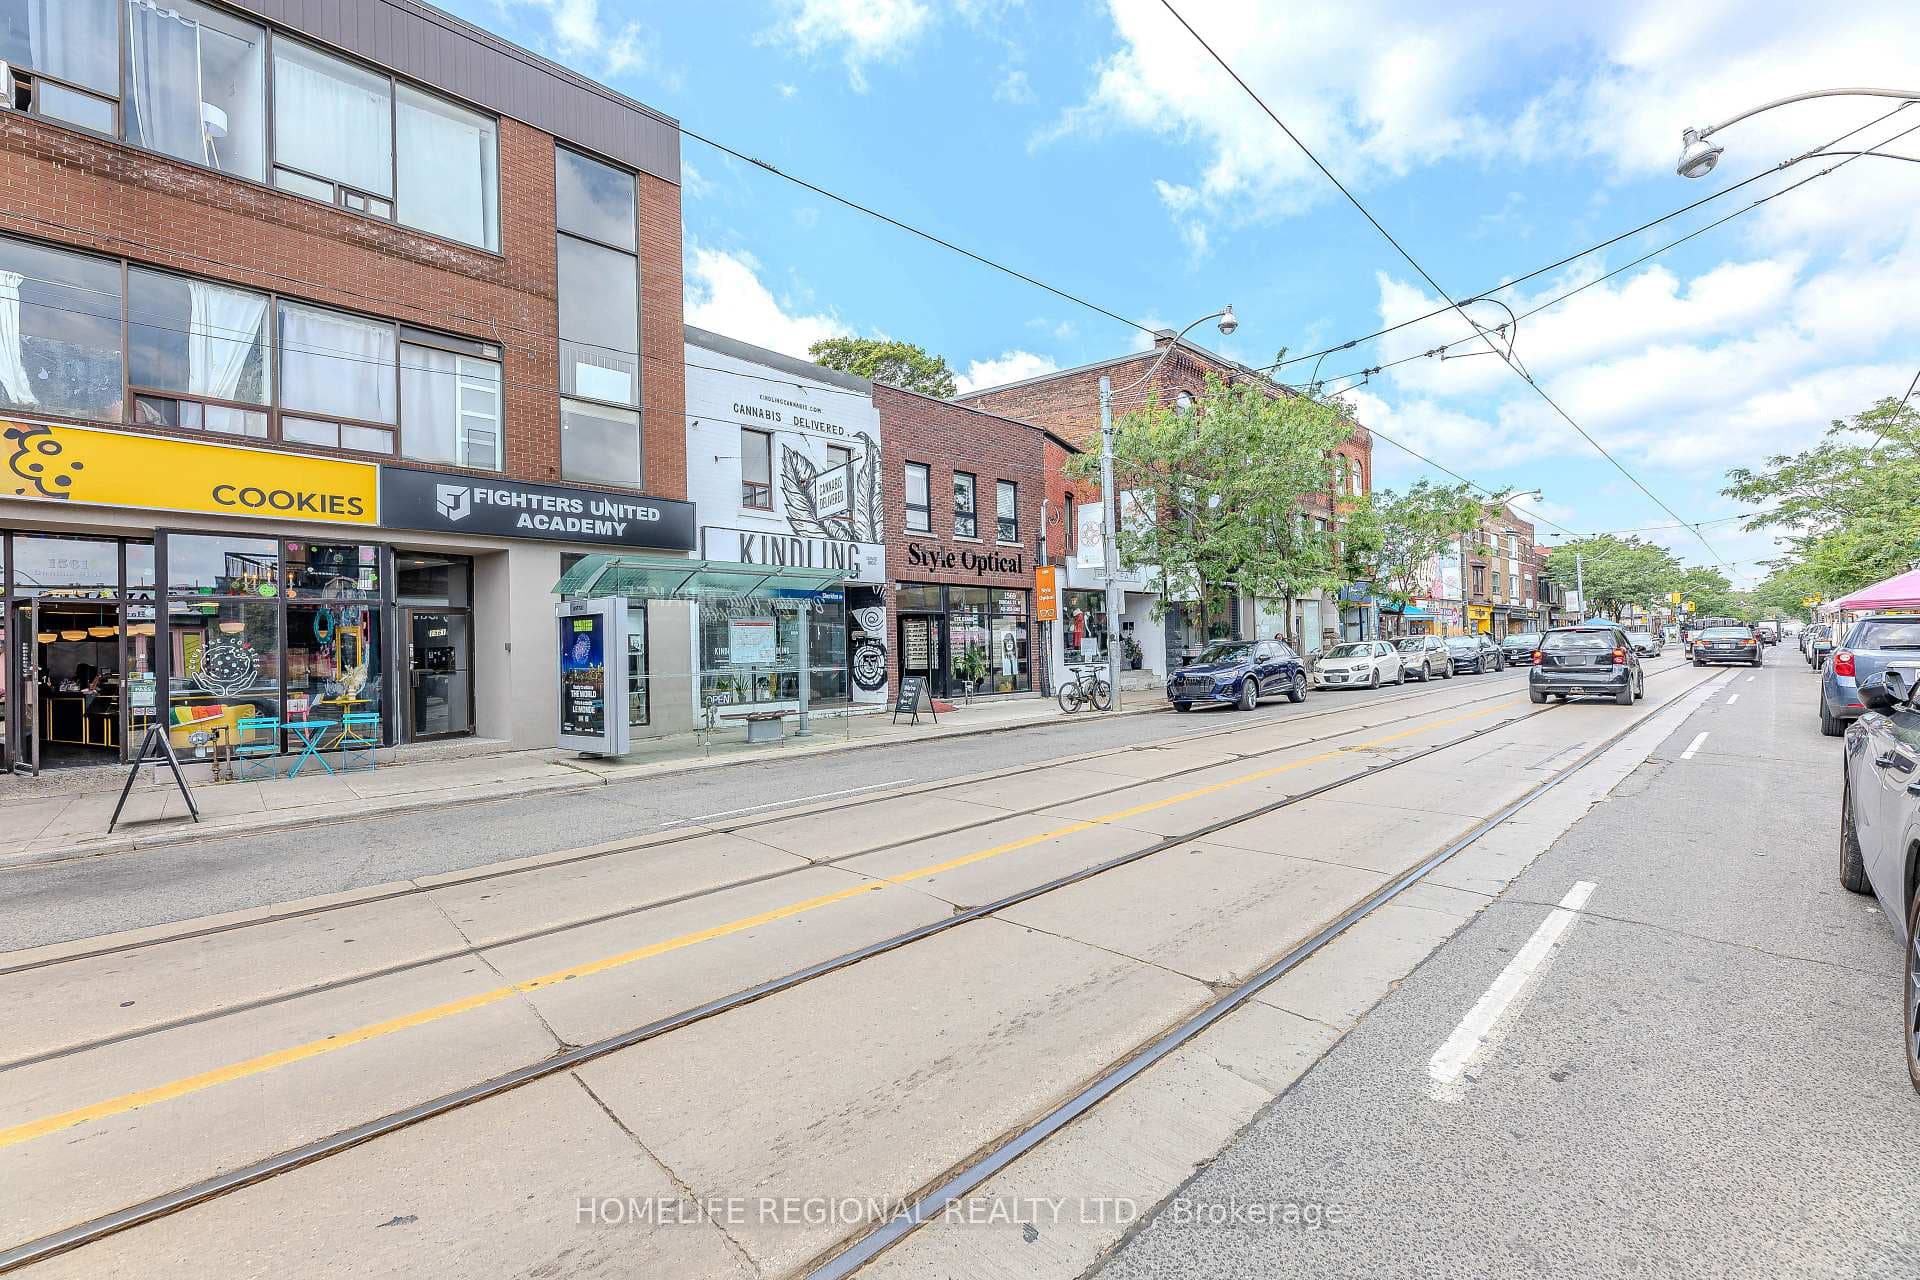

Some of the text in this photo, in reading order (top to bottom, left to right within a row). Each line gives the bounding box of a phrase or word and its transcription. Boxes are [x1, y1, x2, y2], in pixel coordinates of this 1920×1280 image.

[733, 403, 782, 422] CANNABIS
[819, 476, 843, 492] CANNABIS
[212, 484, 364, 516] COOKIES
[473, 488, 661, 522] FIGHTERS UNITED
[516, 513, 627, 537] ACADEMY
[740, 533, 861, 580] KINDLING
[908, 543, 1023, 576] Style Optical
[1004, 592, 1017, 600] 1569
[230, 638, 261, 668] COKIES
[705, 694, 730, 705] OPEN
